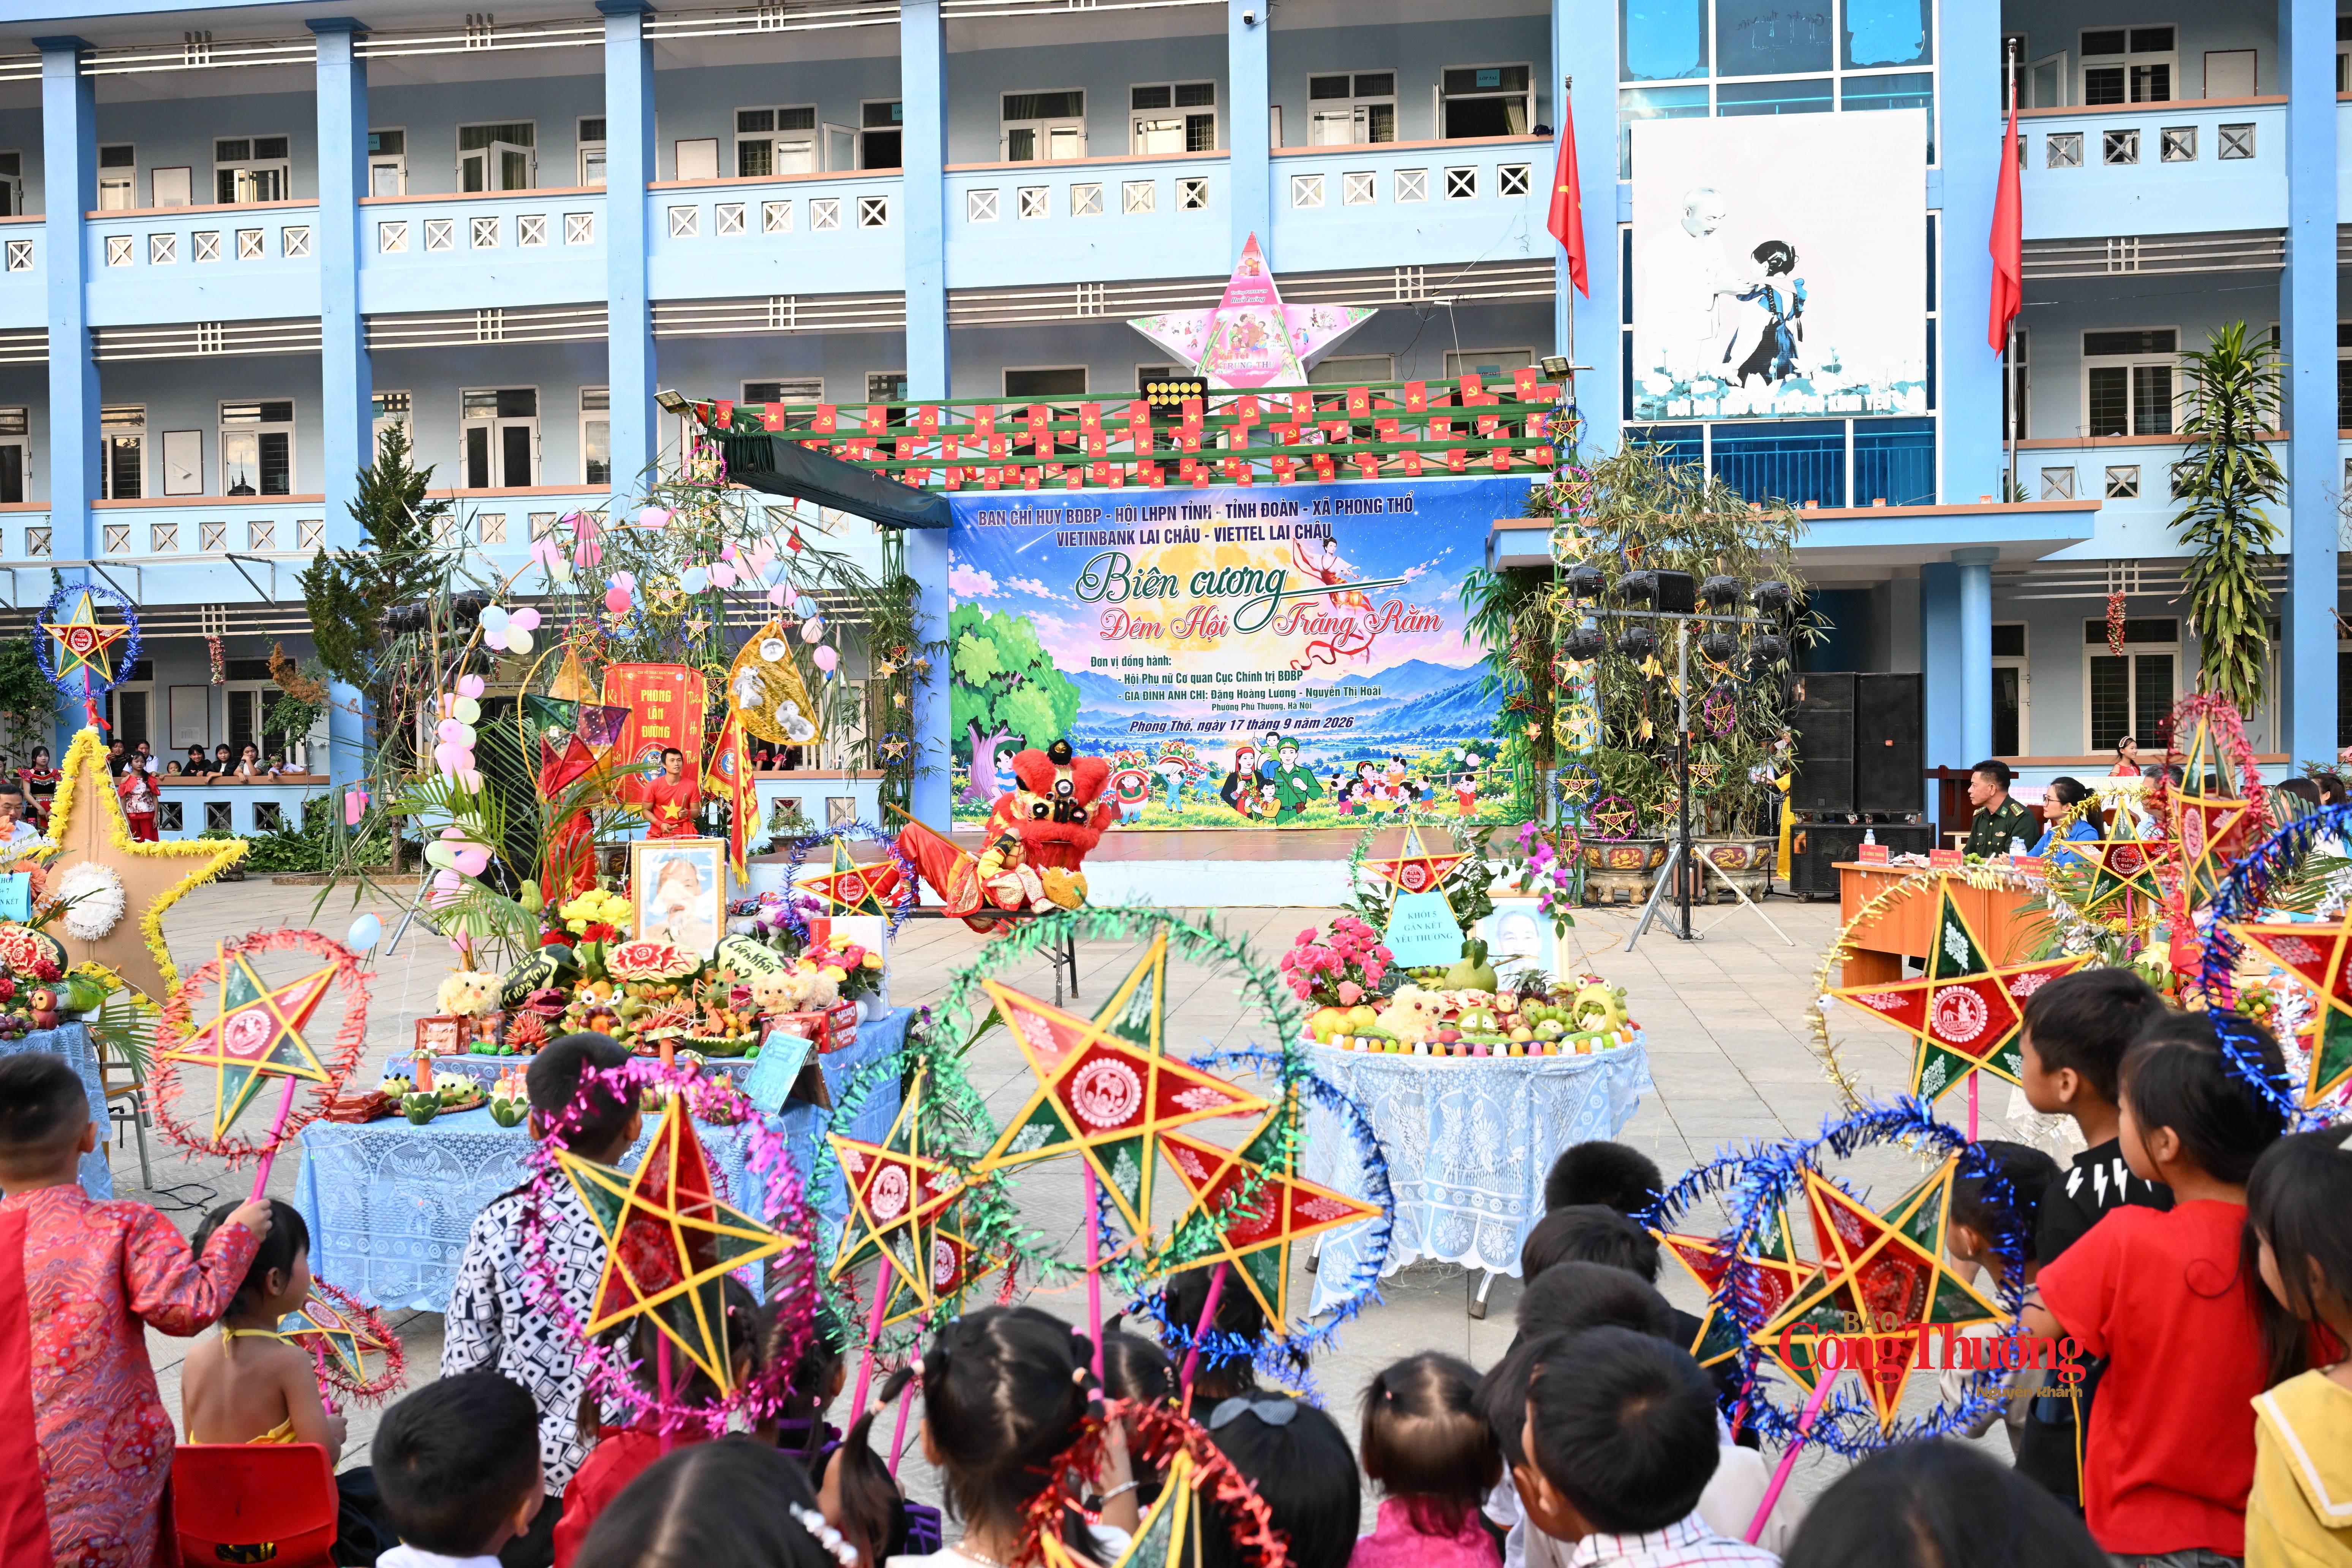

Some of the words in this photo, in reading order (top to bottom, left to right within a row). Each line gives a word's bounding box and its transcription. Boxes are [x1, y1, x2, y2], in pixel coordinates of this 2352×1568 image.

[1218, 351, 1233, 360] Vui
[1222, 361, 1252, 370] TRUNG
[1827, 392, 1862, 412] KÍNH
[979, 511, 1005, 526] BAN
[1012, 505, 1032, 525] CHỈ
[1037, 509, 1062, 524] HUY
[1066, 509, 1101, 523] BĐBP
[1116, 504, 1137, 525] HỘI
[1142, 506, 1176, 522] LHPN
[1181, 500, 1211, 520] TỈNH
[1225, 498, 1256, 518] TỈNH
[1260, 498, 1298, 517] ĐOÀN
[1313, 497, 1331, 515] XÃ
[1336, 498, 1382, 515] PHONG
[1387, 491, 1413, 513] THỔ
[1057, 530, 1135, 547] VIETINBANK
[1140, 529, 1160, 544] LAI
[1164, 525, 1200, 544] CHÂU
[1214, 526, 1265, 542] VIETTEL
[1269, 525, 1290, 540] LAI
[1295, 520, 1331, 539] CHÂU
[1075, 552, 1178, 602] Biên
[1100, 606, 1165, 640] Đêm
[1170, 605, 1229, 641] Hội
[1273, 601, 1358, 647] Trăng
[1364, 599, 1443, 633] Rằm
[1091, 656, 1108, 667] Đơn
[1111, 656, 1118, 669] vị
[1122, 654, 1143, 667] đồng
[1147, 655, 1171, 666] hành:
[1124, 673, 1139, 687] Hội
[1142, 673, 1159, 686] Phụ
[1162, 673, 1173, 684] nữ
[1176, 673, 1188, 684] Cơ
[1190, 674, 1212, 684] quan
[1216, 672, 1233, 685] Cục
[1236, 671, 1262, 682] Chính
[1265, 671, 1275, 684] trị
[1278, 670, 1303, 681] BĐBP
[641, 689, 672, 702] PHONG
[688, 691, 702, 705] Thiên
[1125, 691, 1140, 701] GIA
[1143, 688, 1165, 700] ĐÌNH
[1168, 691, 1187, 700] ANH
[1190, 690, 1208, 702] CHỊ:
[1211, 689, 1234, 701] Đặng
[1237, 689, 1265, 699] Hoàng
[1269, 689, 1296, 699] Lương
[1306, 685, 1340, 698] Nguyễn
[1343, 687, 1357, 698] Thị
[1360, 686, 1381, 696] Hoài
[648, 705, 664, 720] LÂN
[1212, 703, 1239, 712] Phường
[1257, 703, 1285, 711] Thượng,
[1299, 702, 1312, 711] Nội
[642, 724, 670, 738] ĐƯỜNG
[1129, 721, 1167, 733] Phong
[1170, 718, 1194, 732] Thổ,
[1197, 719, 1227, 732] ngày
[1230, 719, 1245, 730] 17
[1247, 718, 1280, 731] tháng
[1283, 718, 1292, 729] 9
[1293, 717, 1320, 729] năm
[1323, 717, 1354, 728] 2026
[639, 748, 649, 758] THUẬT
[686, 750, 697, 764] Thái
[1396, 934, 1412, 943] YÊU
[1415, 933, 1453, 942] THƯƠNG
